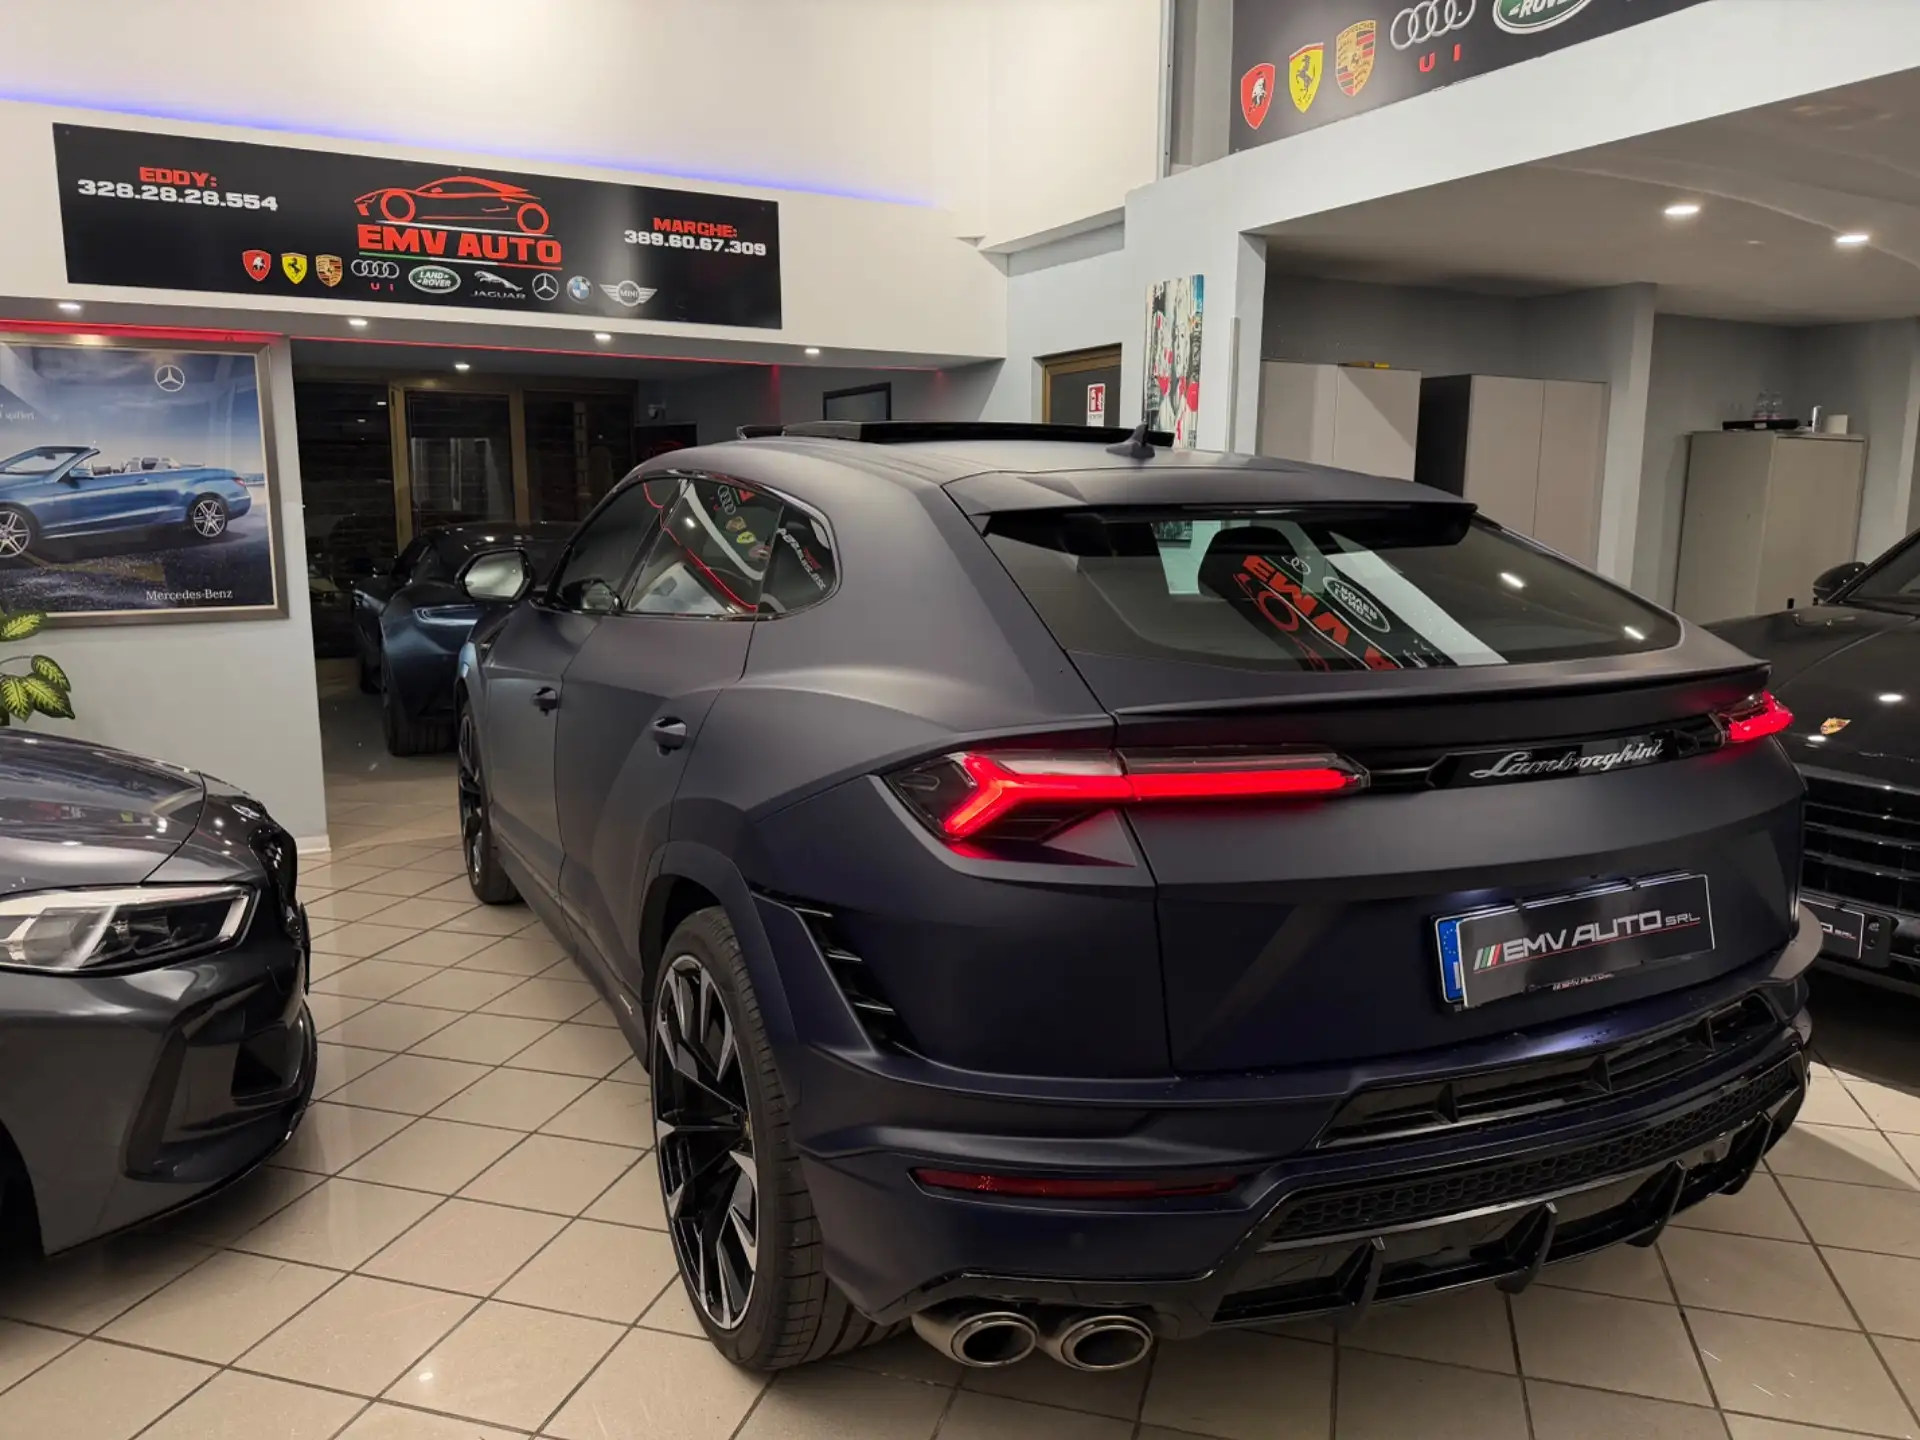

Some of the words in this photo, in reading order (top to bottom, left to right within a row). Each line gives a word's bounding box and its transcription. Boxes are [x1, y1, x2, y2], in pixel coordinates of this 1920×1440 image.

[139, 166, 218, 188] EDDY:
[77, 179, 279, 212] 328.28.28.554
[652, 217, 738, 238] MARCHE:
[357, 223, 448, 255] EMV
[457, 231, 563, 264] AUTO
[624, 229, 767, 256] 389.60.67.309
[420, 271, 444, 280] LAND
[421, 278, 452, 287] ROVER
[470, 290, 527, 300] JAGUAR
[619, 289, 639, 299] MINI
[1469, 738, 1664, 779] Lamborghini
[1502, 928, 1567, 962] EMV
[1571, 909, 1663, 947] AUTO
[1665, 912, 1701, 927] SRL
